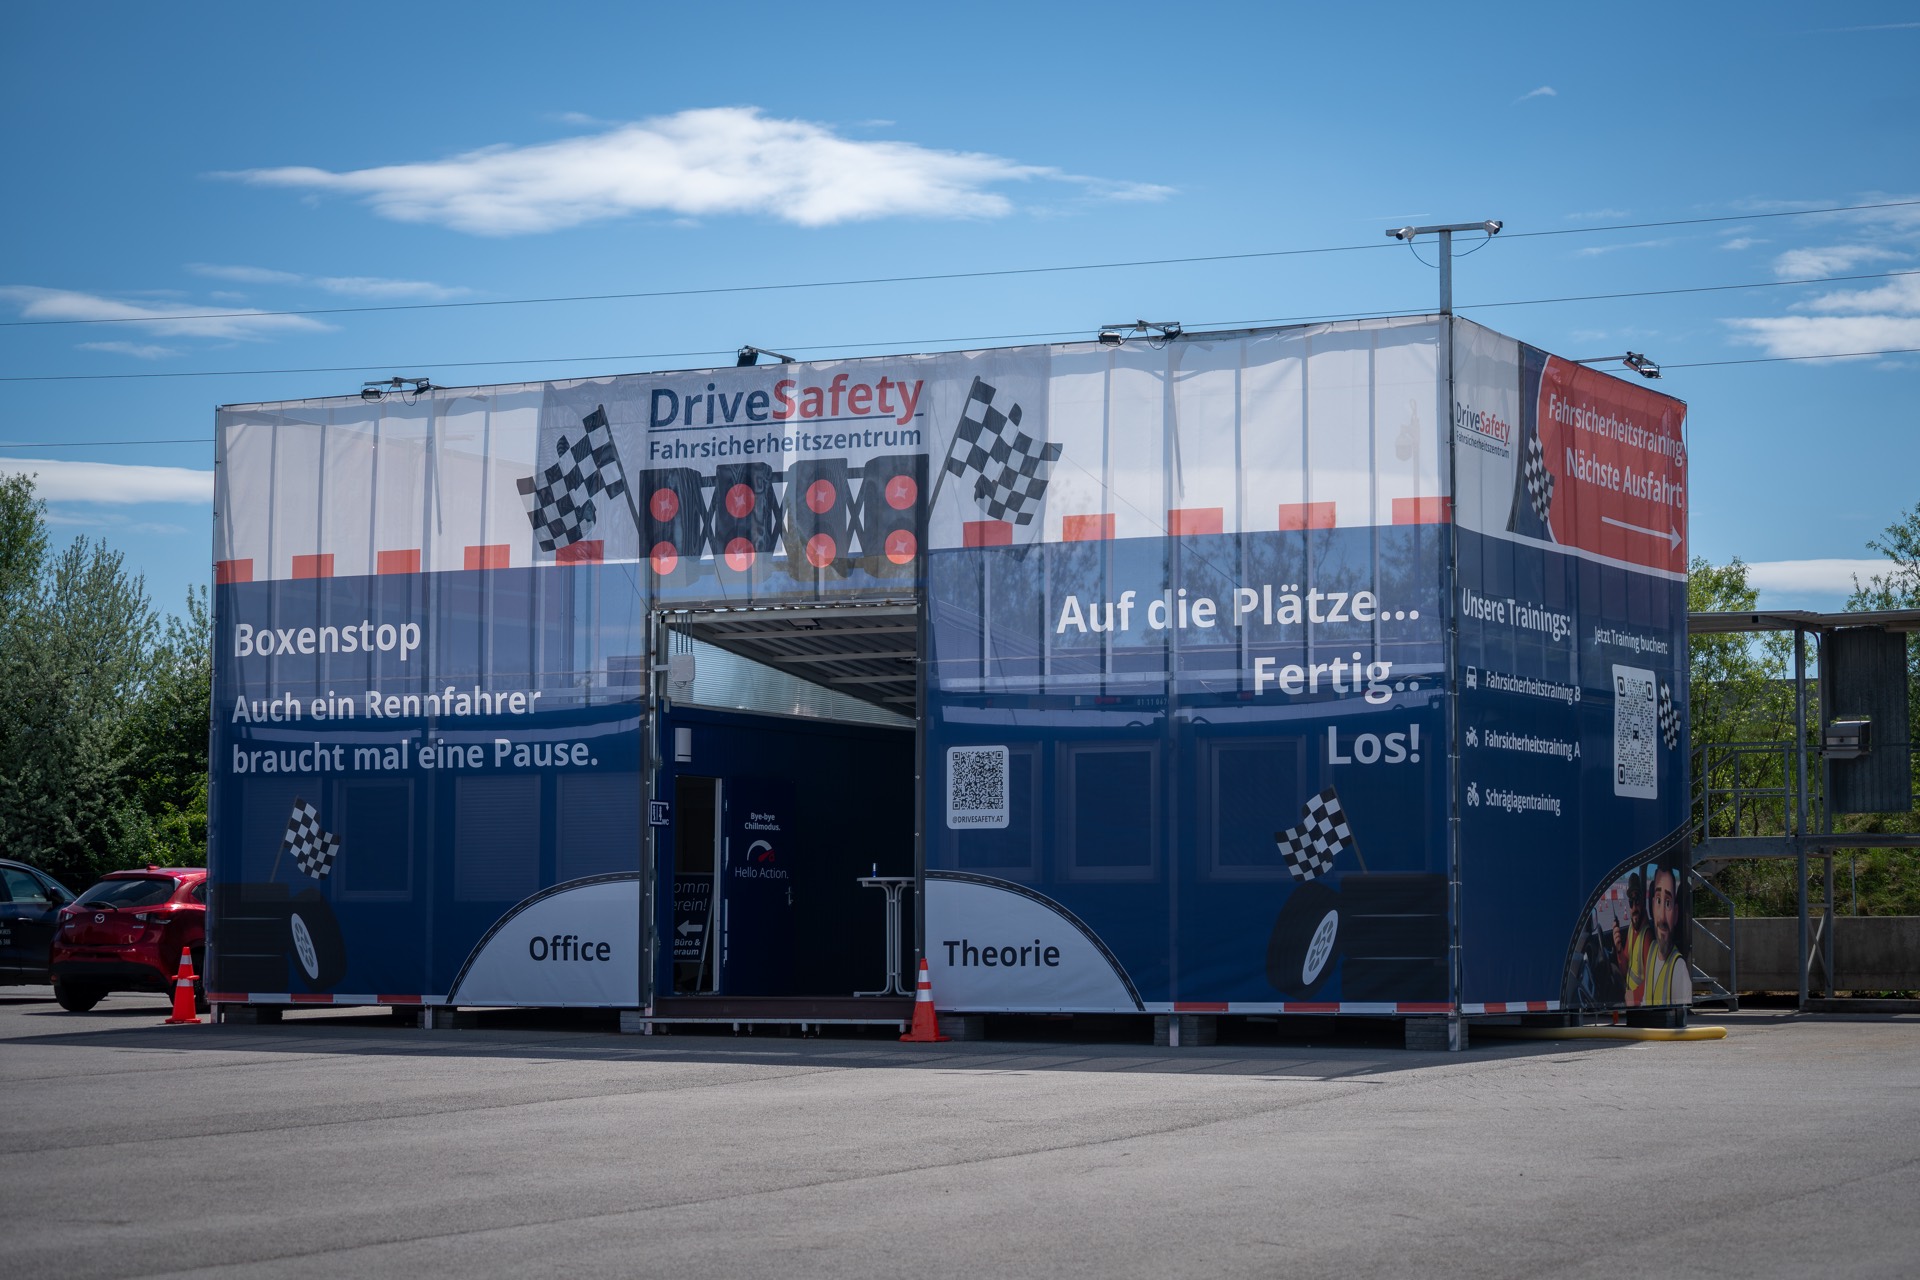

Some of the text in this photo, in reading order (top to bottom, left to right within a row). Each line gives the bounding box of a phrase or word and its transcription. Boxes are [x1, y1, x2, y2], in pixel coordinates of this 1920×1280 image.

[649, 373, 925, 426] DriveSafety
[1456, 401, 1510, 446] DriveSafety
[1549, 393, 1683, 467] Fahrsicherheitstraining
[649, 427, 921, 460] Fahrsicherheitszentrum
[1456, 430, 1510, 459] Fahrsicherheitszentrum
[1566, 447, 1683, 509] Nächste Ausfahrt
[1056, 584, 1420, 634] Auf die Plätze...
[1462, 587, 1571, 642] Unsere Trainings:
[234, 619, 421, 661] Boxenstop
[1594, 626, 1668, 655] Jetzt Training buchen:
[232, 685, 541, 723] Auch ein Rennfahrer
[1486, 671, 1581, 705] Fahrsicherheitstraining B
[233, 738, 598, 773] braucht mal eine Pause.
[1328, 723, 1420, 764] Los!
[1484, 730, 1581, 761] Fahrsicherheitstraining A
[750, 812, 776, 822] Bye-bye
[1485, 788, 1561, 816] Schräglagentraining
[744, 822, 781, 831] Chillmodus.
[674, 882, 710, 894] omm
[734, 866, 789, 879] Hello Action.
[529, 935, 611, 962] Office
[674, 938, 701, 946] Büro &
[943, 939, 1060, 968] Theorie
